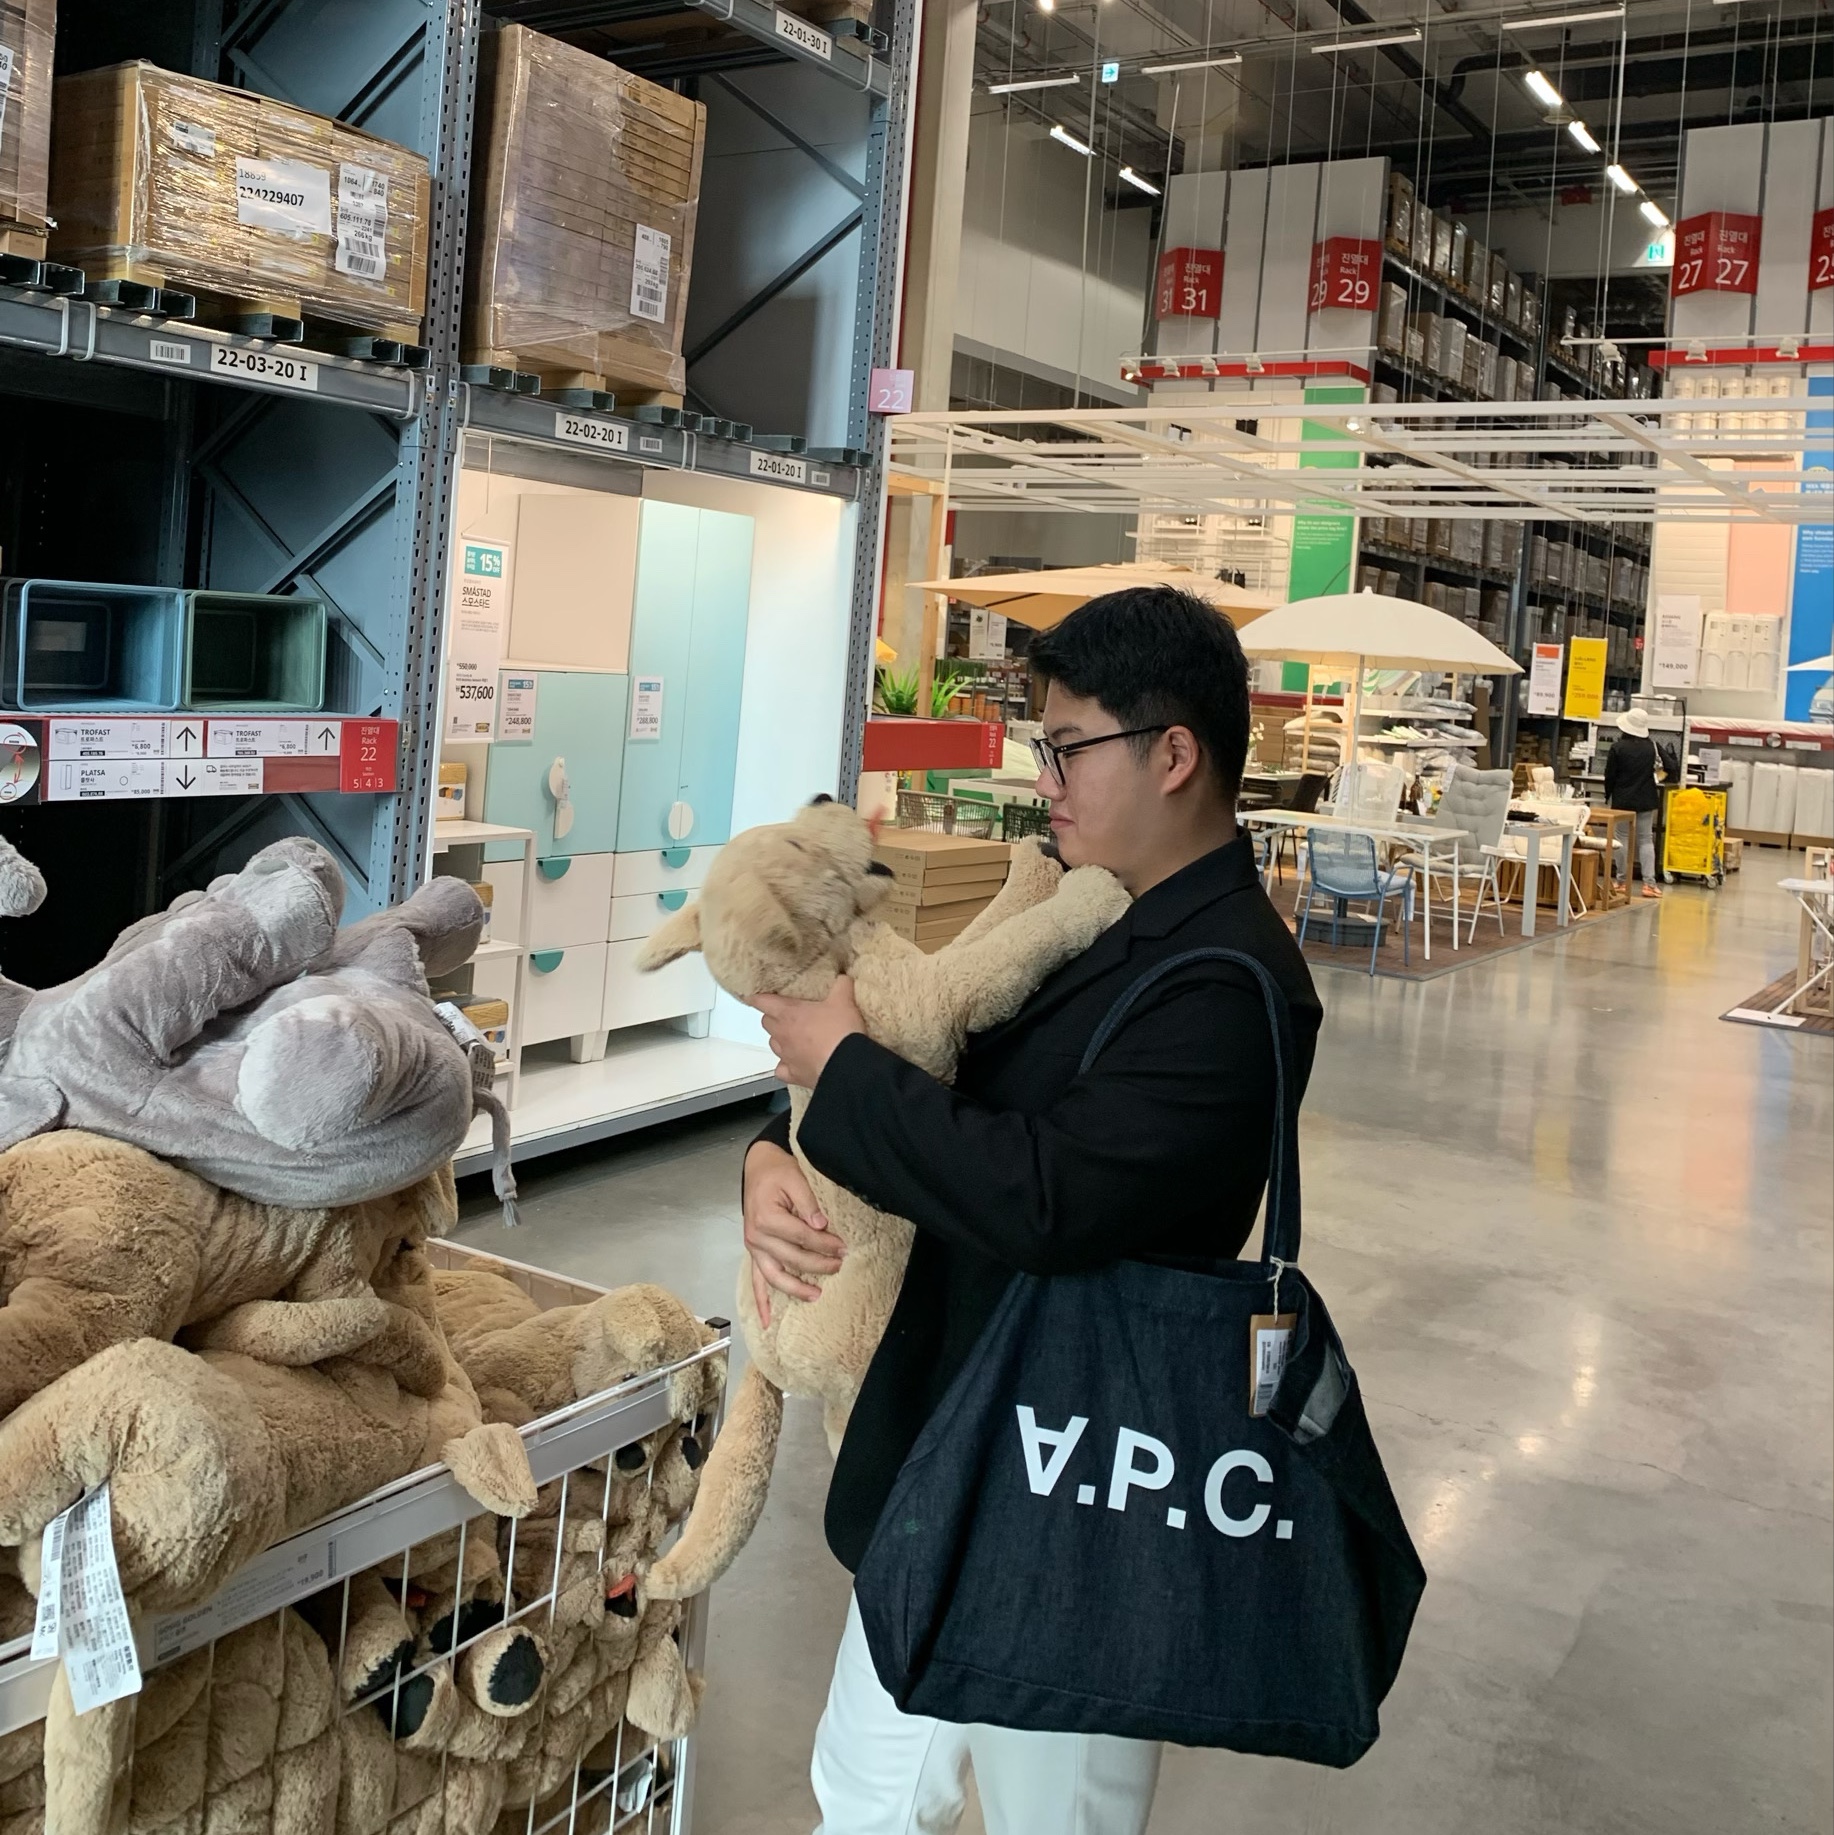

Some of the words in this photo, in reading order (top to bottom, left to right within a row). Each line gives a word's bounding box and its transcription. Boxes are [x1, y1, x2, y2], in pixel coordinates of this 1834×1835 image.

[783, 20, 821, 50] 22-01-30
[239, 186, 305, 207] 224229407
[1339, 266, 1358, 275] Rack
[1678, 259, 1704, 290] 27
[1715, 258, 1749, 286] 27
[1181, 287, 1207, 312] 31
[1311, 280, 1328, 306] 29
[1337, 278, 1370, 304] 29
[217, 349, 295, 379] 22-03-20
[299, 366, 308, 382] I
[877, 388, 905, 410] 22
[565, 420, 615, 443] 22-02-20
[757, 458, 796, 477] 22-01-20
[462, 585, 492, 598] SMÅSTAD
[361, 726, 380, 735] 진열대
[361, 736, 378, 745] Rack
[360, 746, 377, 762] 22
[80, 769, 106, 777] PLATSA
[353, 778, 360, 789] 5
[365, 778, 372, 788] 4
[377, 777, 384, 788] 3
